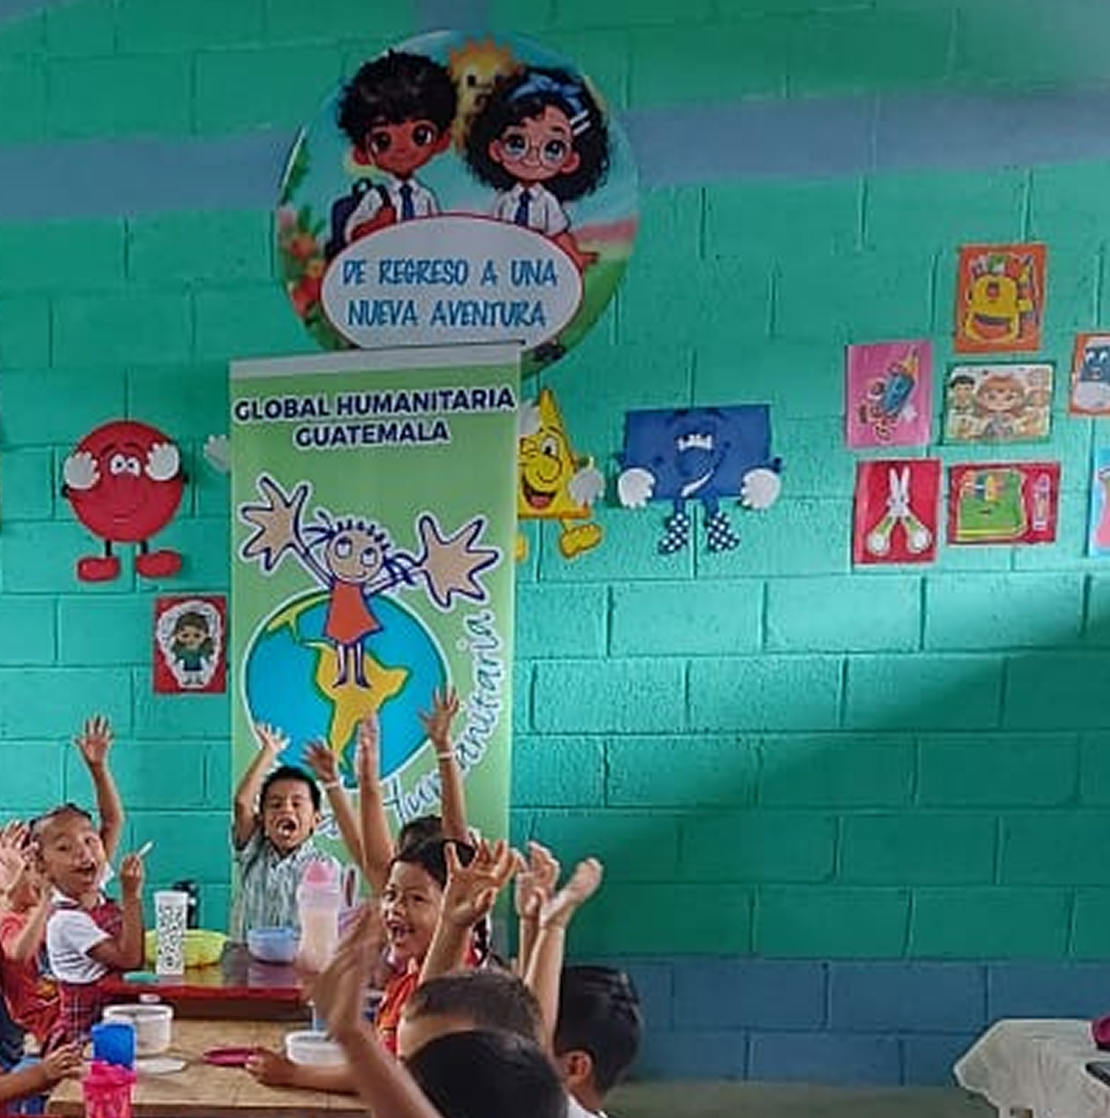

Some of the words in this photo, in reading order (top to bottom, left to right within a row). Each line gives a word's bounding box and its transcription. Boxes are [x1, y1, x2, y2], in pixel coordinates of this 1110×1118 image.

[342, 259, 367, 285] DE
[379, 259, 469, 286] REGRESO
[482, 259, 497, 286] A
[510, 260, 558, 287] UNA
[348, 300, 418, 327] NUEVA
[431, 301, 547, 328] AVENTURA
[234, 396, 330, 421] GLOBAL
[337, 388, 515, 416] HUMANITARIA
[296, 423, 449, 447] GUATEMALA
